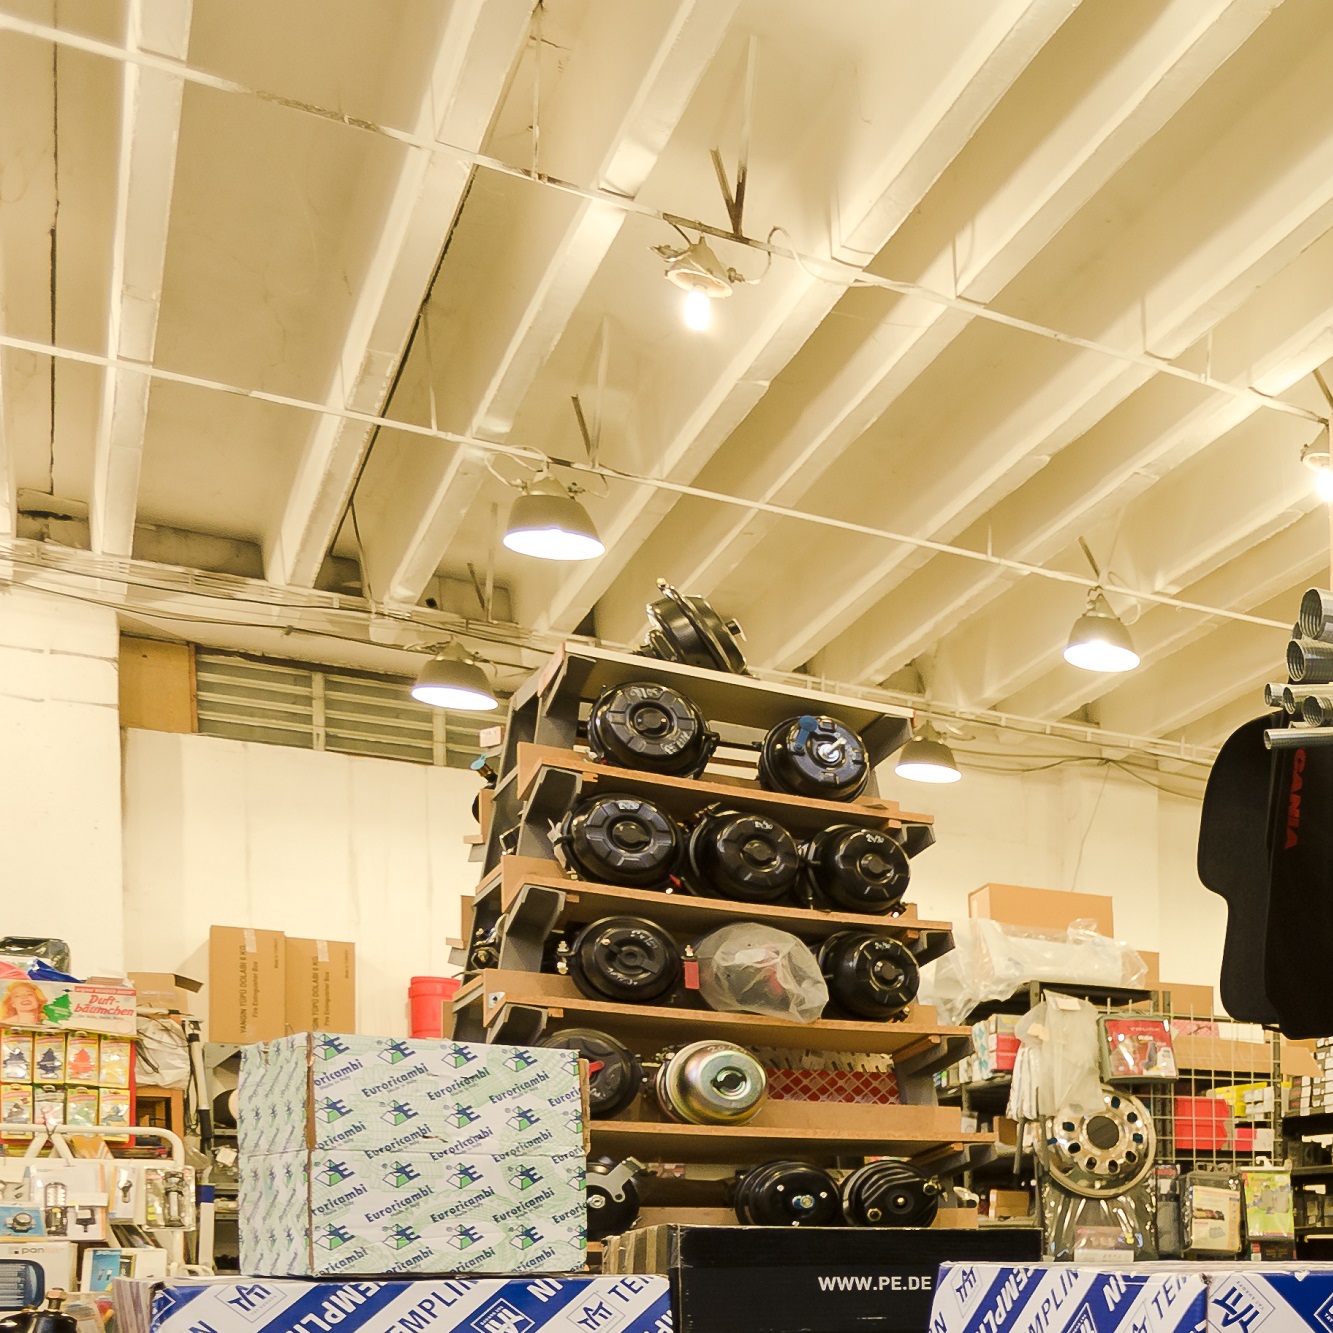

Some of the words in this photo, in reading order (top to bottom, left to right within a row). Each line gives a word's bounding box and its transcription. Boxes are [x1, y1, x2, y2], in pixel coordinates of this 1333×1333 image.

[1284, 748, 1306, 849] CANIA
[74, 1003, 134, 1017] bäumchen
[88, 995, 120, 1005] Duft-
[314, 1059, 363, 1087] oricambi
[361, 1062, 429, 1098] Euroricambi
[427, 1067, 490, 1100] Euroricambi
[489, 1071, 550, 1104] Euroricambi
[317, 1121, 366, 1150] oricambi
[311, 1184, 368, 1216] roricambi
[365, 1185, 434, 1223] Euroricambi
[430, 1186, 495, 1223] Euroricambi
[492, 1187, 554, 1223] Euroricambi
[818, 1276, 932, 1291] WWW.PE.DE
